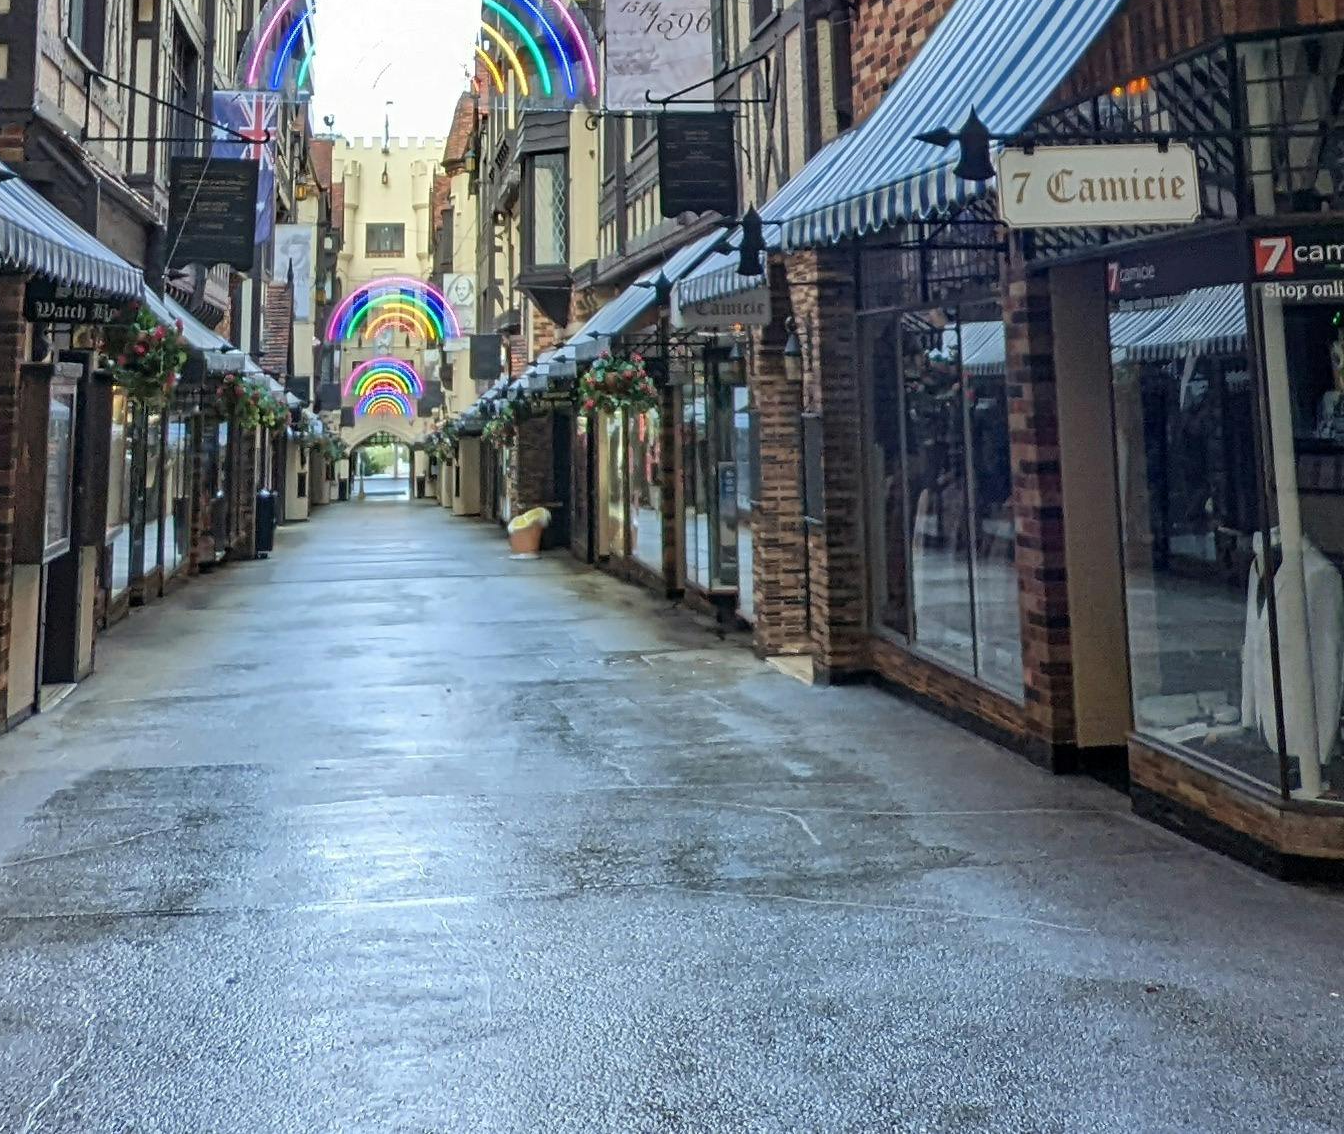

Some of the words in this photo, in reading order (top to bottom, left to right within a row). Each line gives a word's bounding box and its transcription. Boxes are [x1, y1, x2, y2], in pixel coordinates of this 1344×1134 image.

[643, 10, 712, 41] 1596
[1012, 171, 1031, 204] 7
[1047, 168, 1186, 203] Camicie
[1260, 238, 1287, 273] 7
[1264, 282, 1307, 301] Shop
[36, 301, 86, 320] Watch
